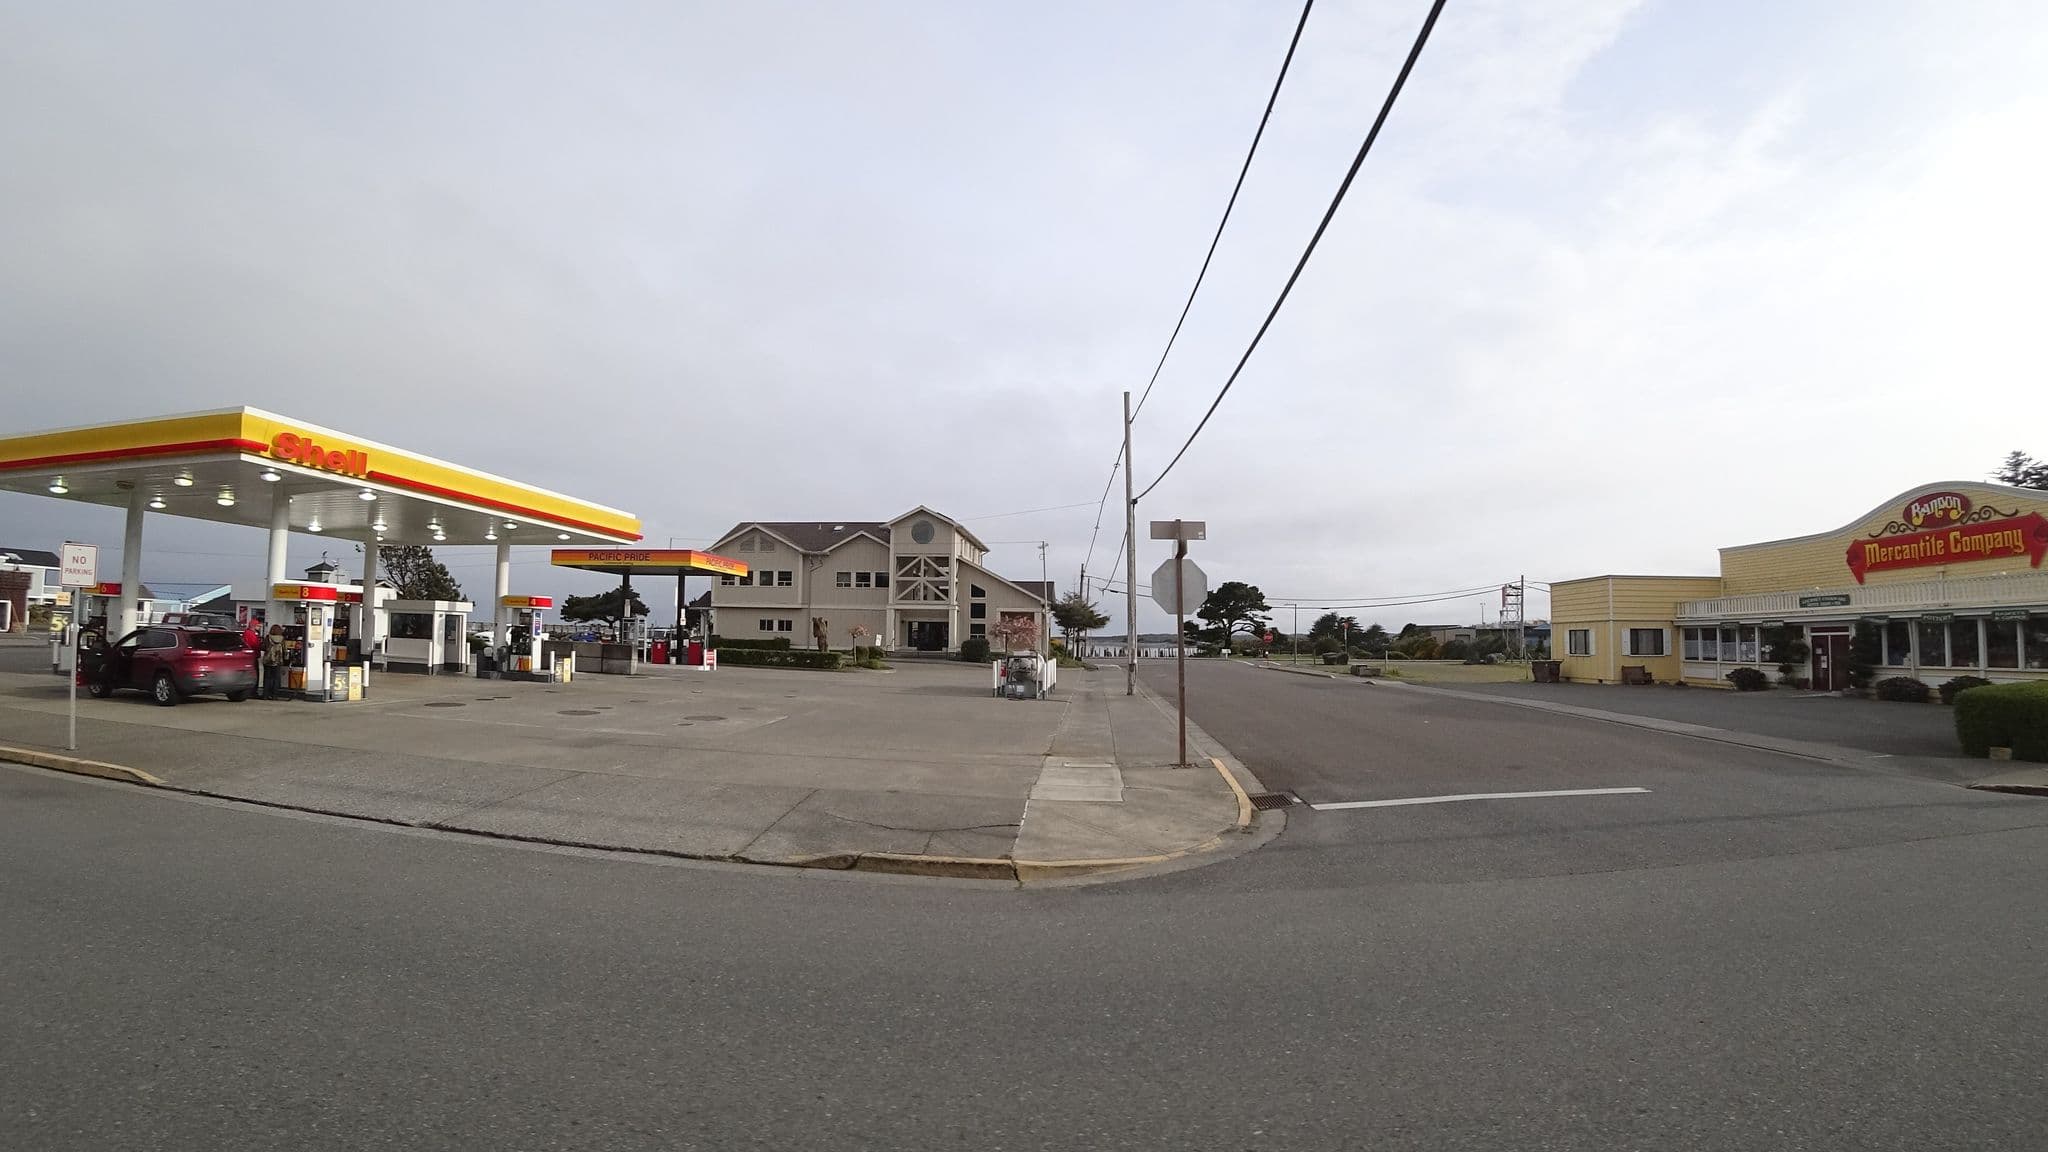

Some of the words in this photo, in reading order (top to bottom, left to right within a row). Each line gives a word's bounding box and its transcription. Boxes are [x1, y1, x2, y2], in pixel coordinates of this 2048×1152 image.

[270, 432, 368, 476] Shell
[1864, 534, 1945, 567] Mercantile
[1950, 528, 2025, 554] Company
[72, 556, 87, 565] NO
[588, 553, 621, 562] PACIFIC
[624, 553, 650, 562] PRIDE
[64, 567, 93, 576] PARKING
[101, 585, 107, 593] 6
[302, 587, 310, 598] 8
[530, 598, 536, 606] 4
